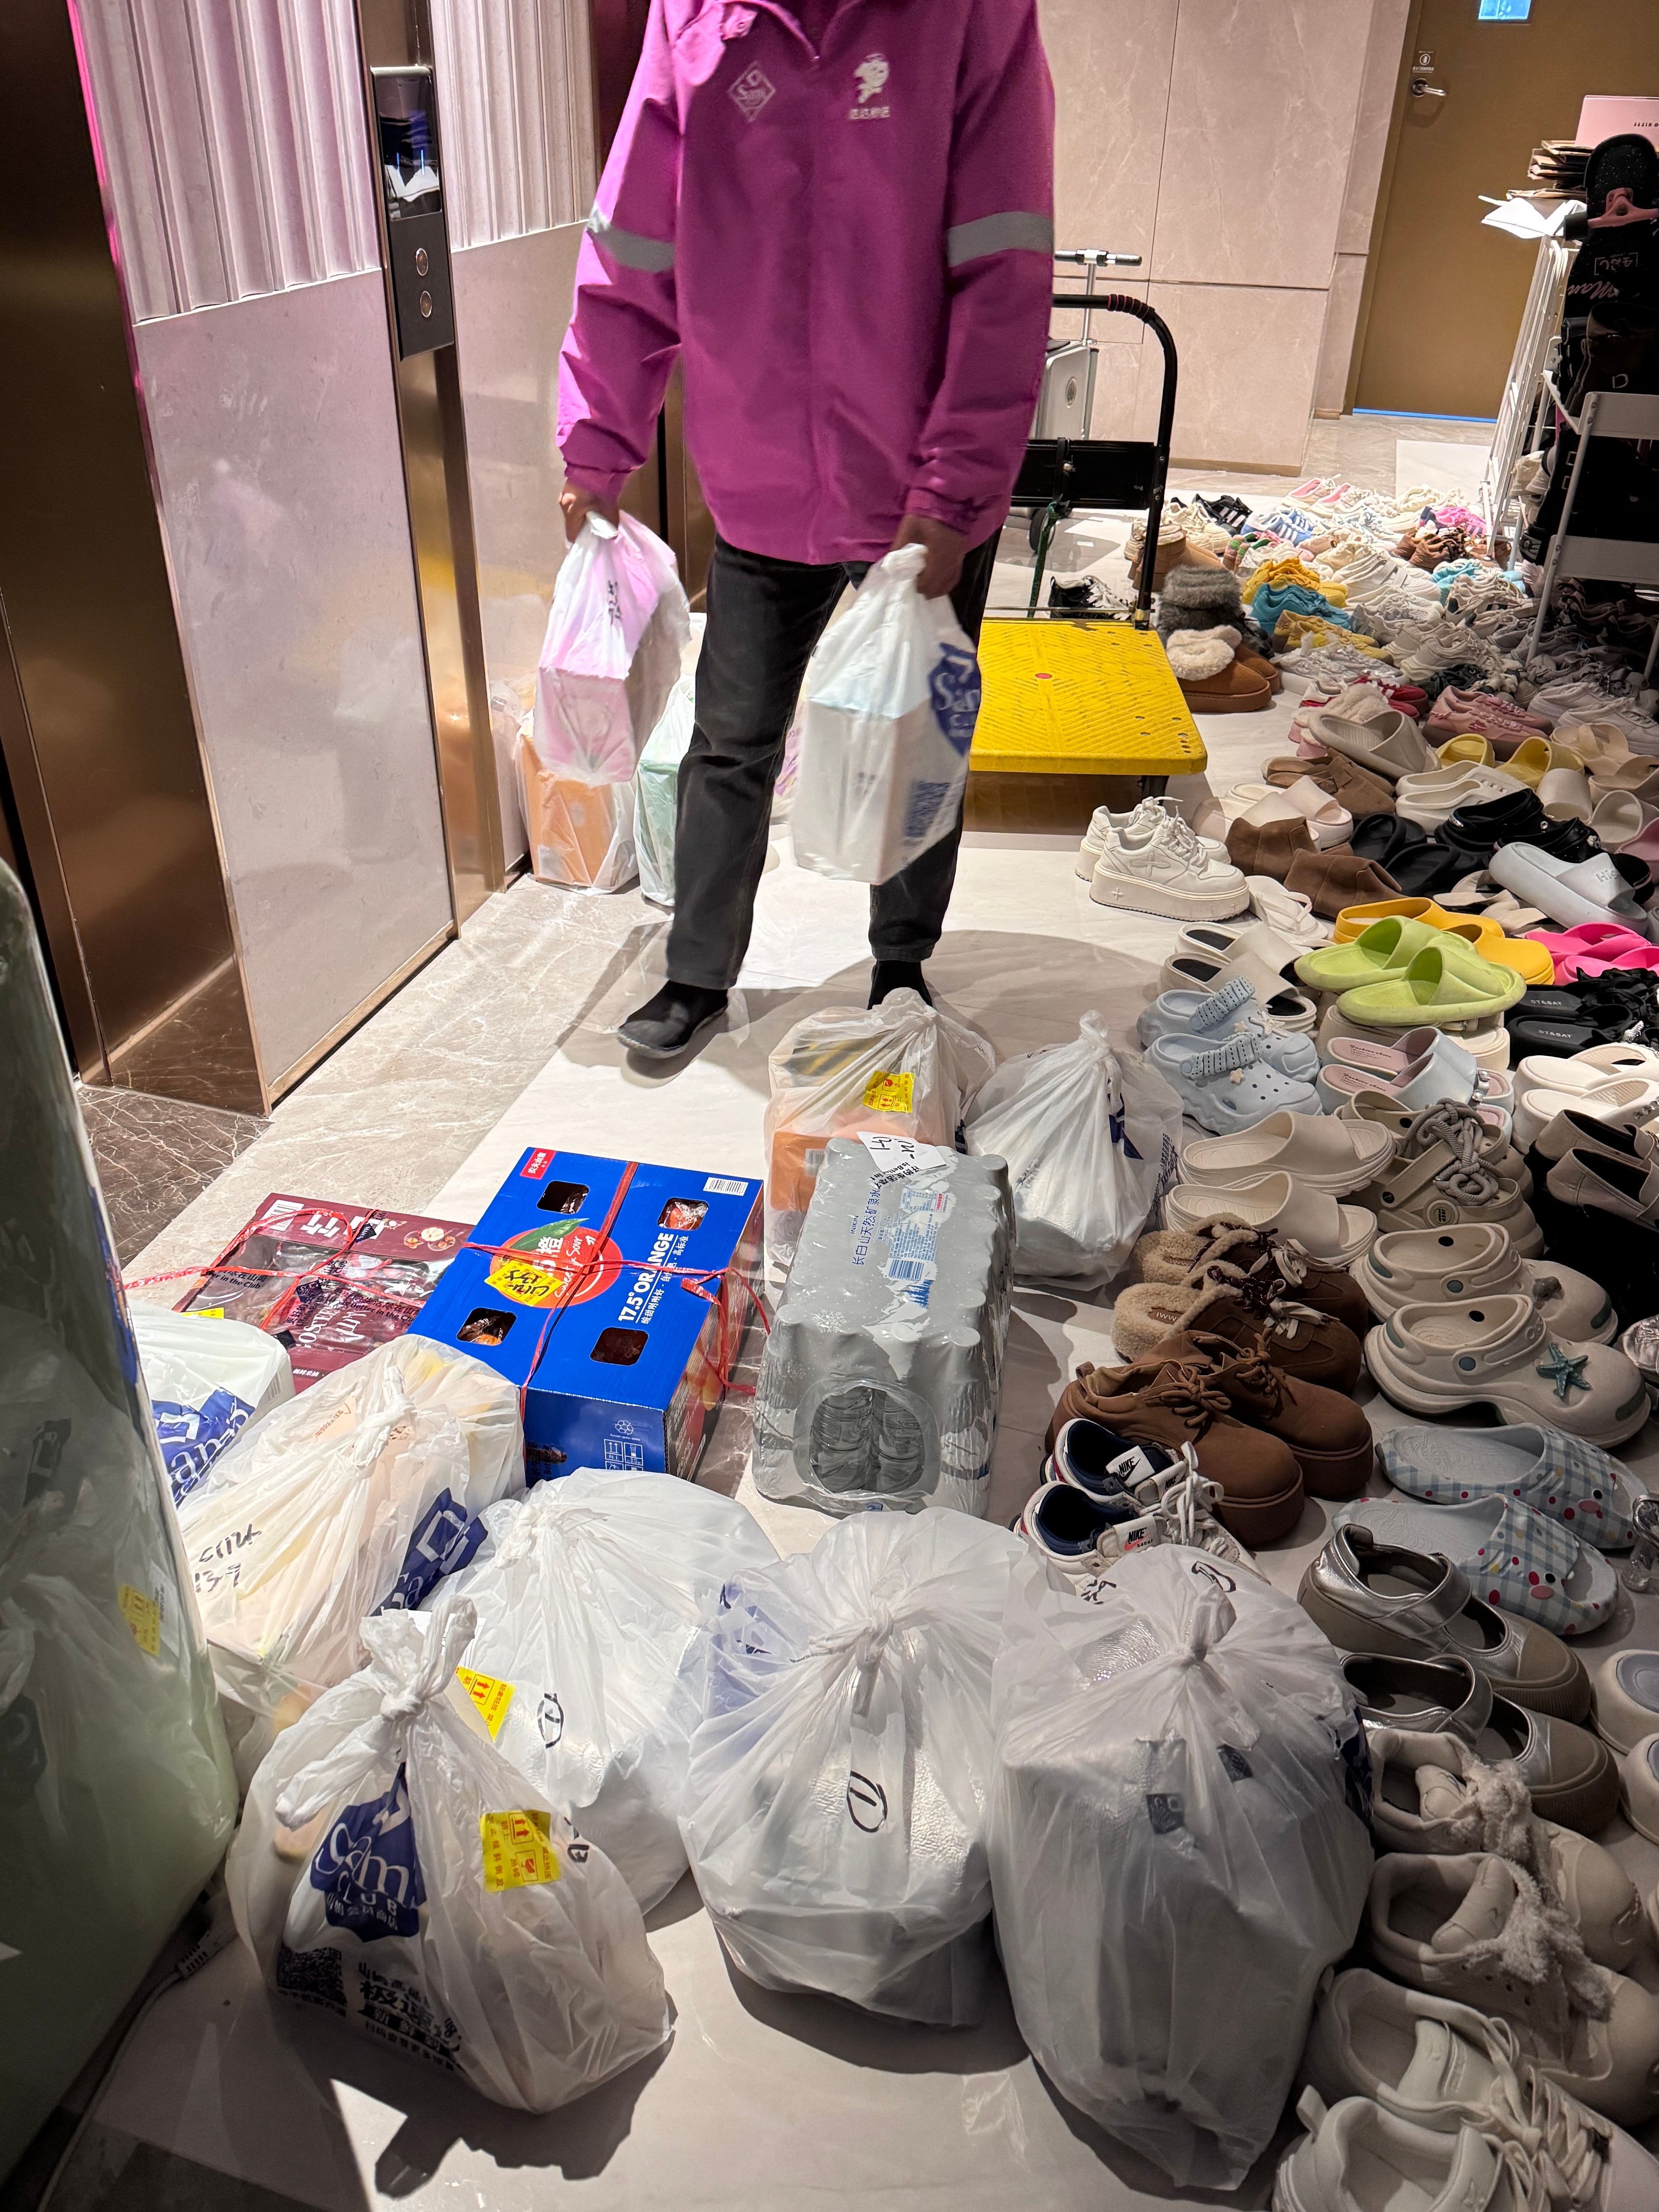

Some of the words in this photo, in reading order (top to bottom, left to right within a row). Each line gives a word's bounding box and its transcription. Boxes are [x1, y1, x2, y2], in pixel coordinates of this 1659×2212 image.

[852, 1188, 882, 1265] 长白山天然矿泉水
[1127, 1527, 1145, 1543] NIKE
[339, 1873, 397, 1916] CLUB
